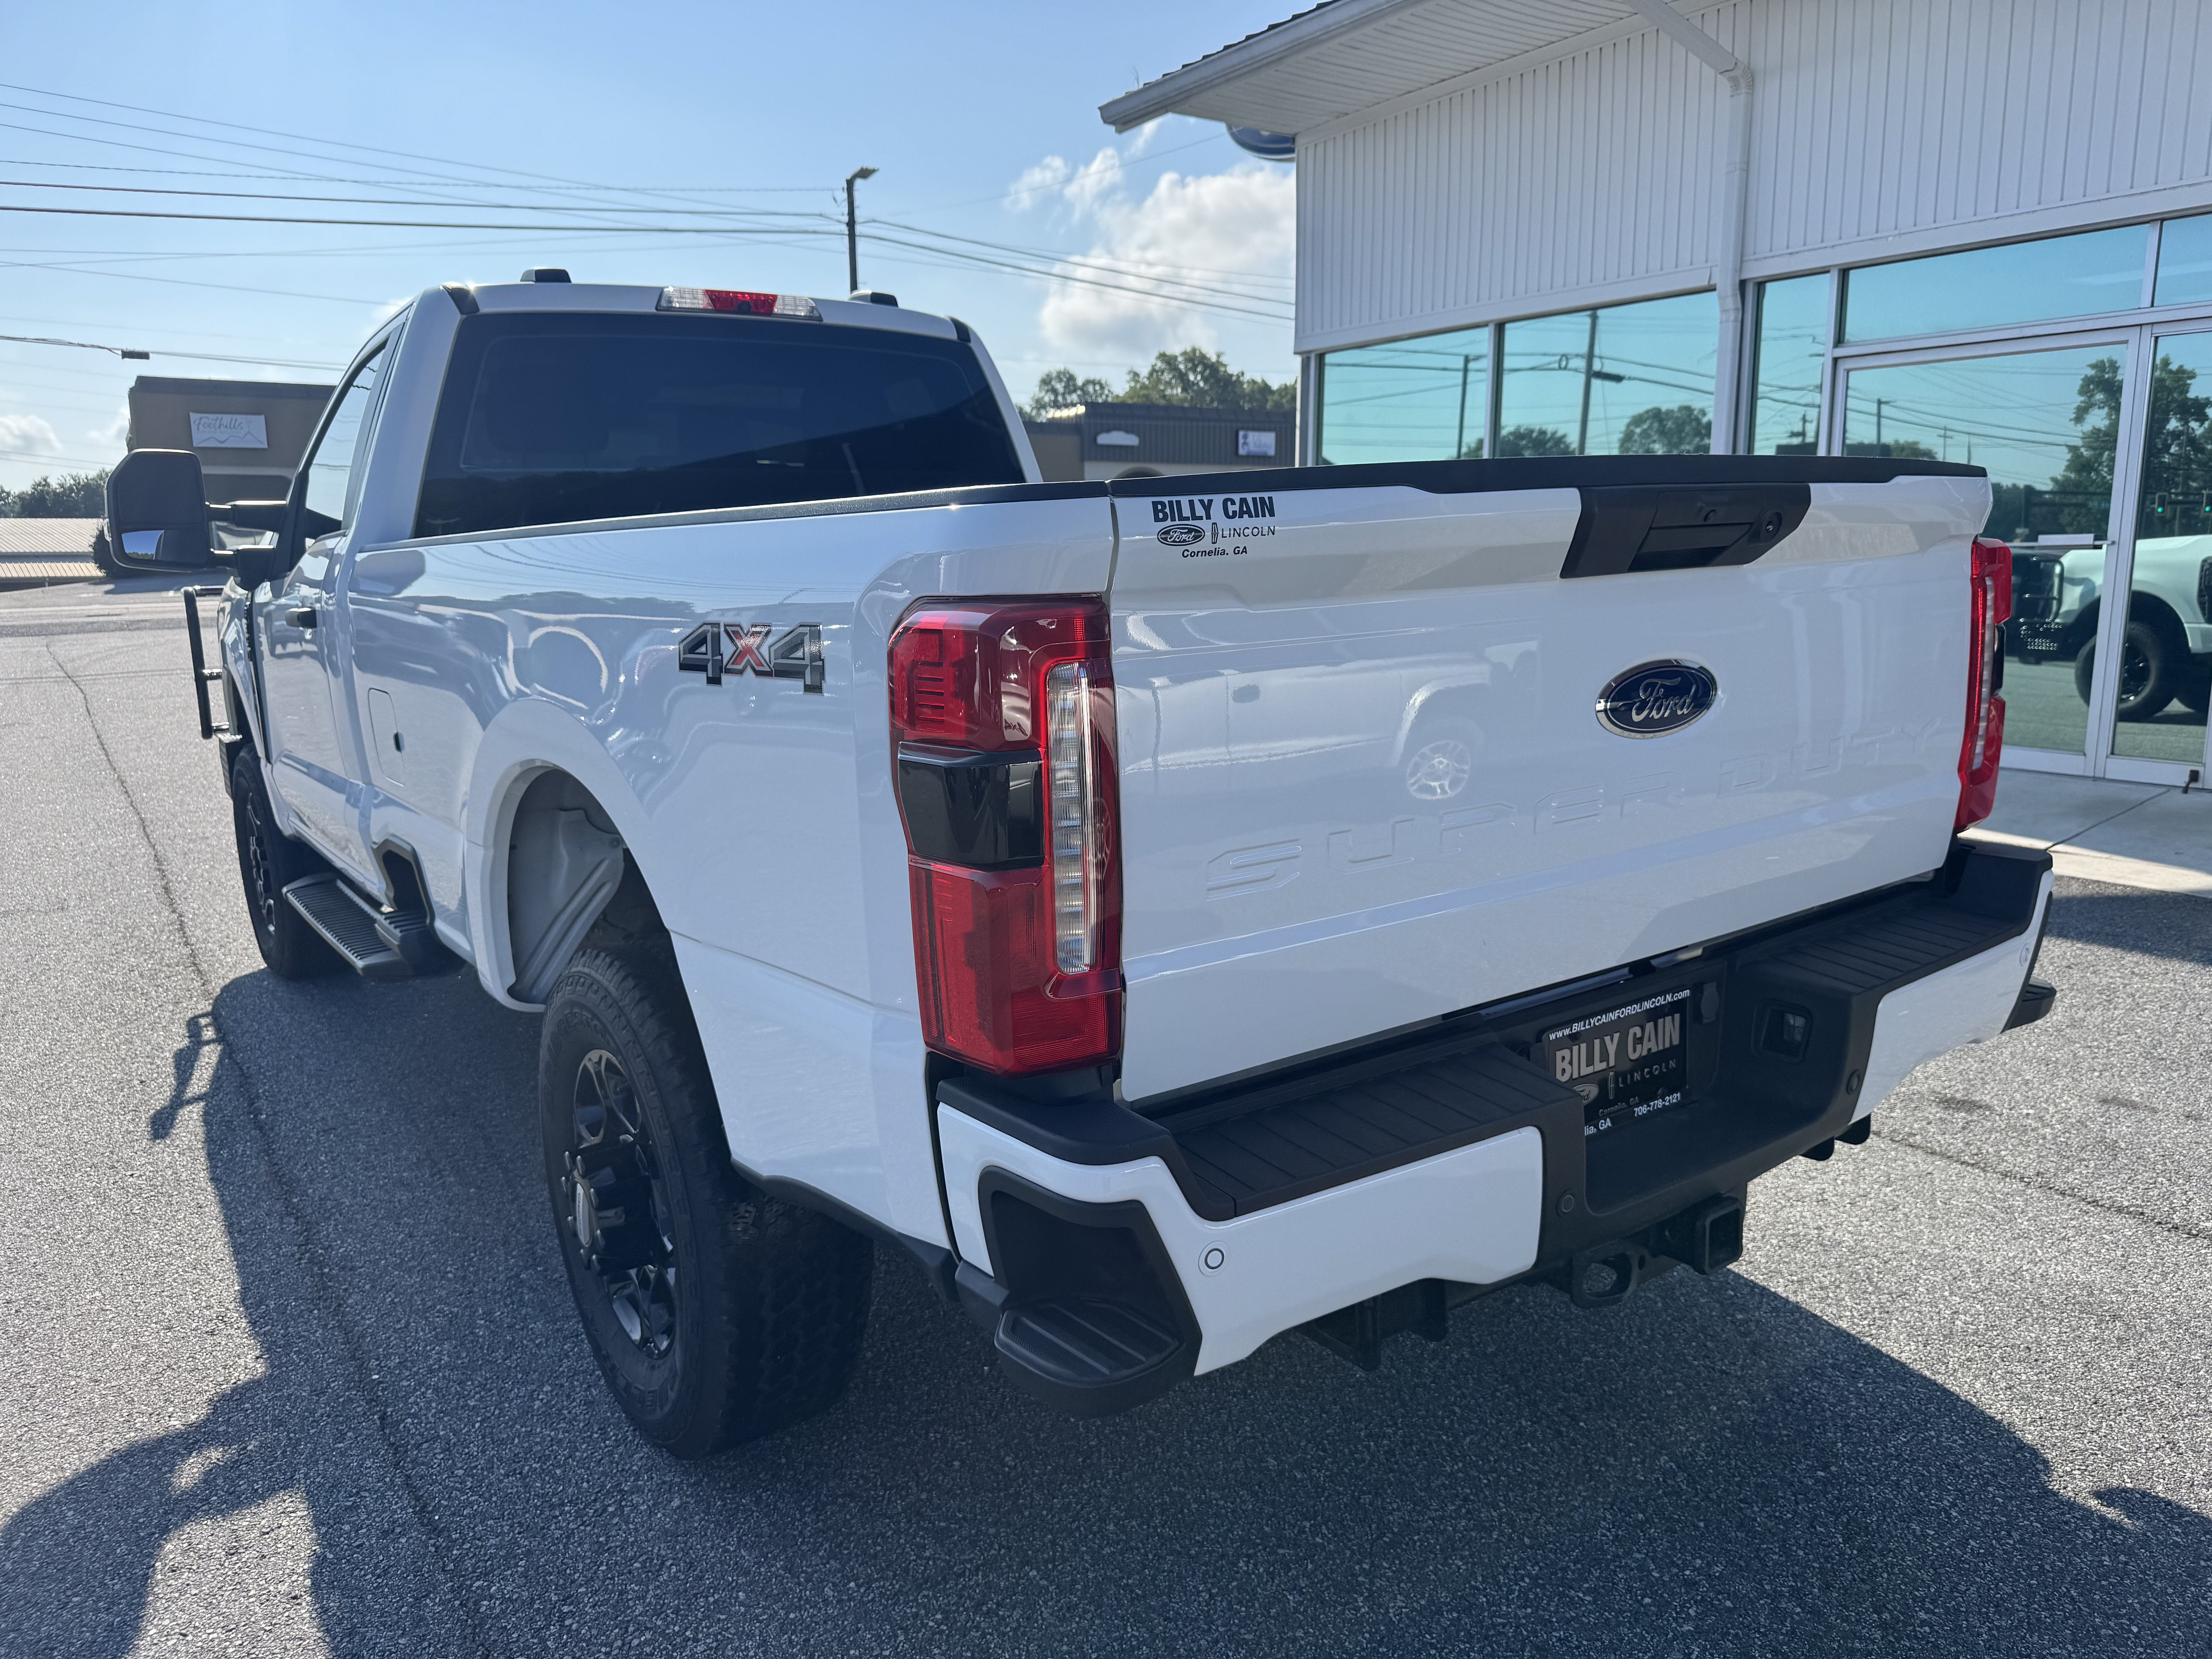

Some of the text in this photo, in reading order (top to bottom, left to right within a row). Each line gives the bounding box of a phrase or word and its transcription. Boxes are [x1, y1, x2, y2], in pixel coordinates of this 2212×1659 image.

[1152, 496, 1275, 522] BILLY CAIN
[1167, 526, 1275, 542] Ford LINCOLN
[1233, 546, 1247, 555] GA
[1632, 677, 1696, 722] Ford
[1206, 771, 1685, 901] SUPER
[1549, 989, 1690, 1041] www.BILLYCAINFORDLINCOLN.com
[1556, 1013, 1680, 1082] BILLY CAIN
[1619, 1059, 1676, 1087] LINCOLN
[1599, 1092, 1680, 1130] GA 706-778-2121
[1630, 1096, 1640, 1105] GA
